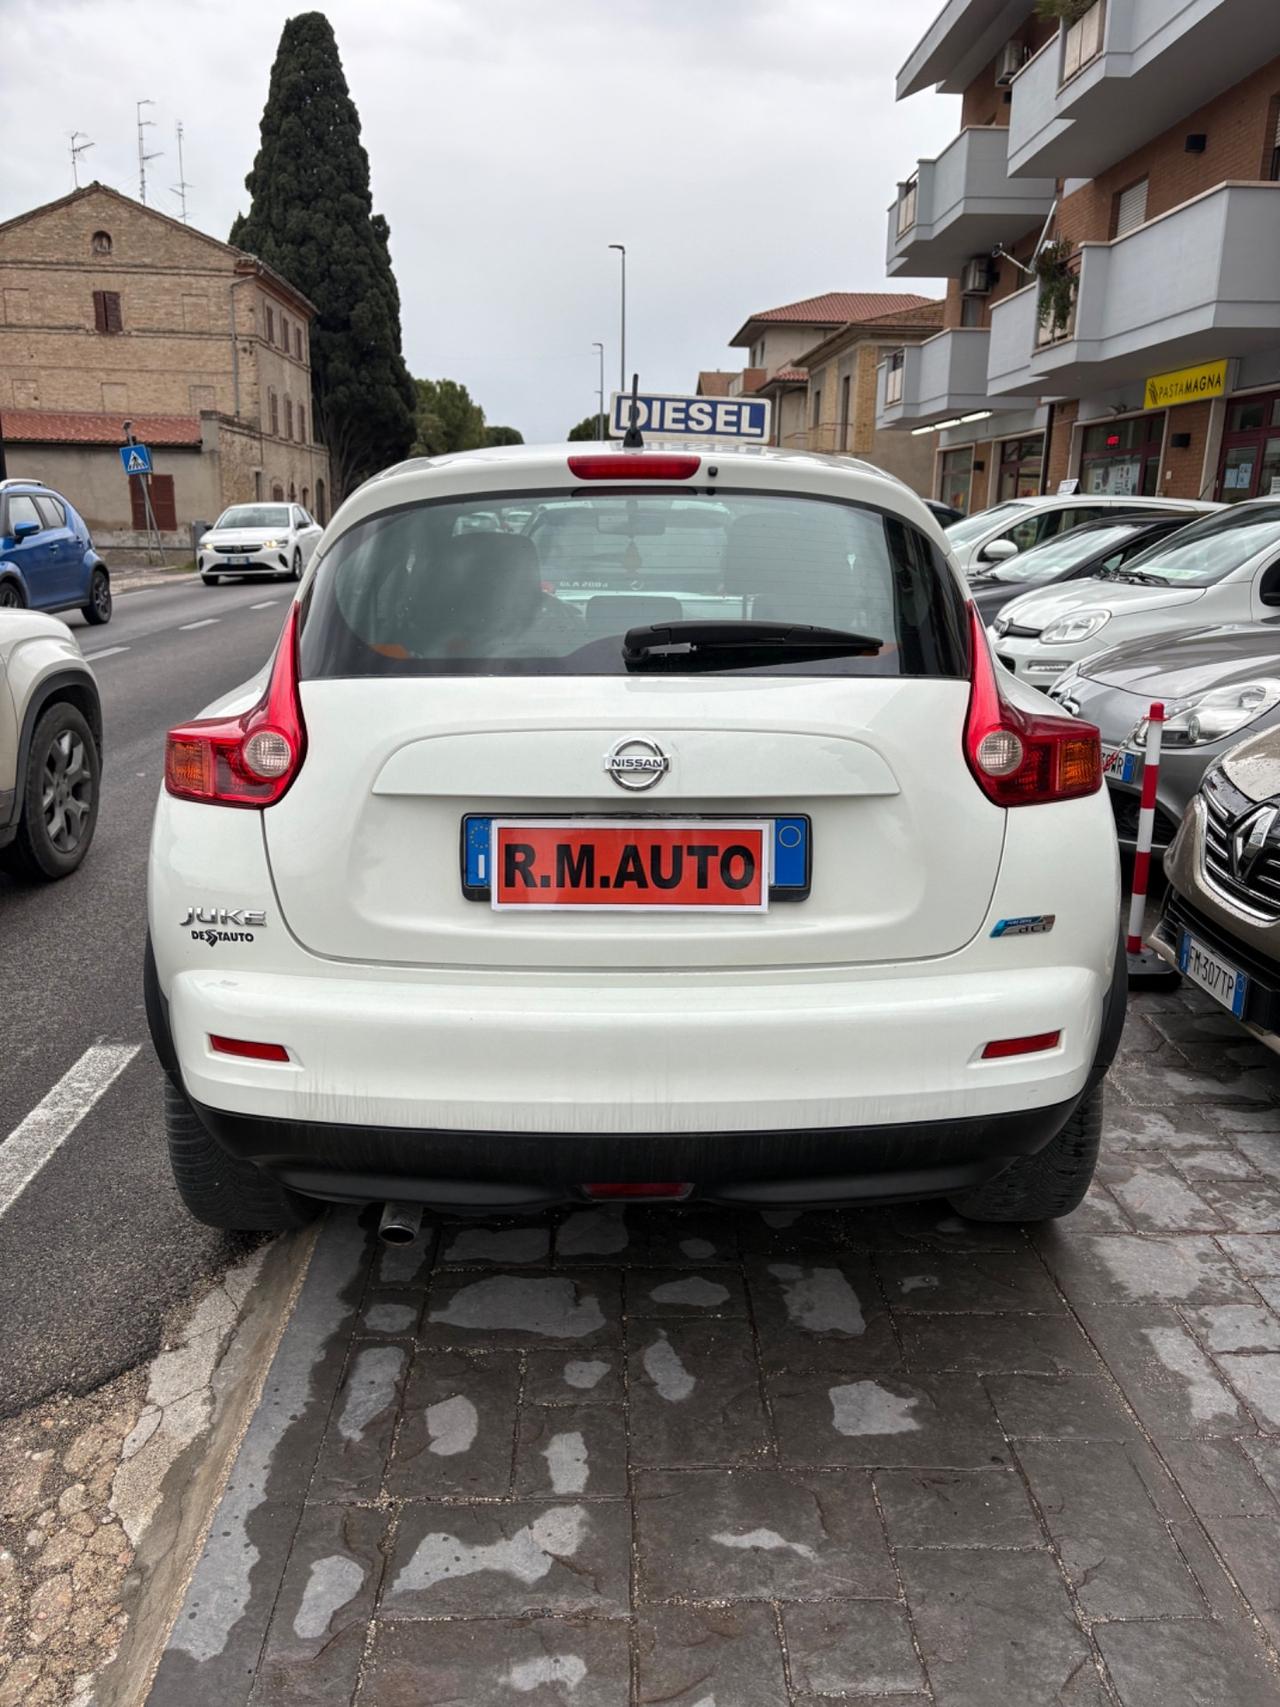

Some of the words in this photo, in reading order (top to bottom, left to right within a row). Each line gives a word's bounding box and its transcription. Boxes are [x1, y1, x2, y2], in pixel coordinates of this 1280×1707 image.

[1159, 373, 1222, 398] PASTAMAGNA
[619, 399, 762, 434] DIESEL
[611, 758, 663, 769] NISSAN
[504, 844, 755, 890] R.M.AUTO
[179, 906, 268, 928] JUKE
